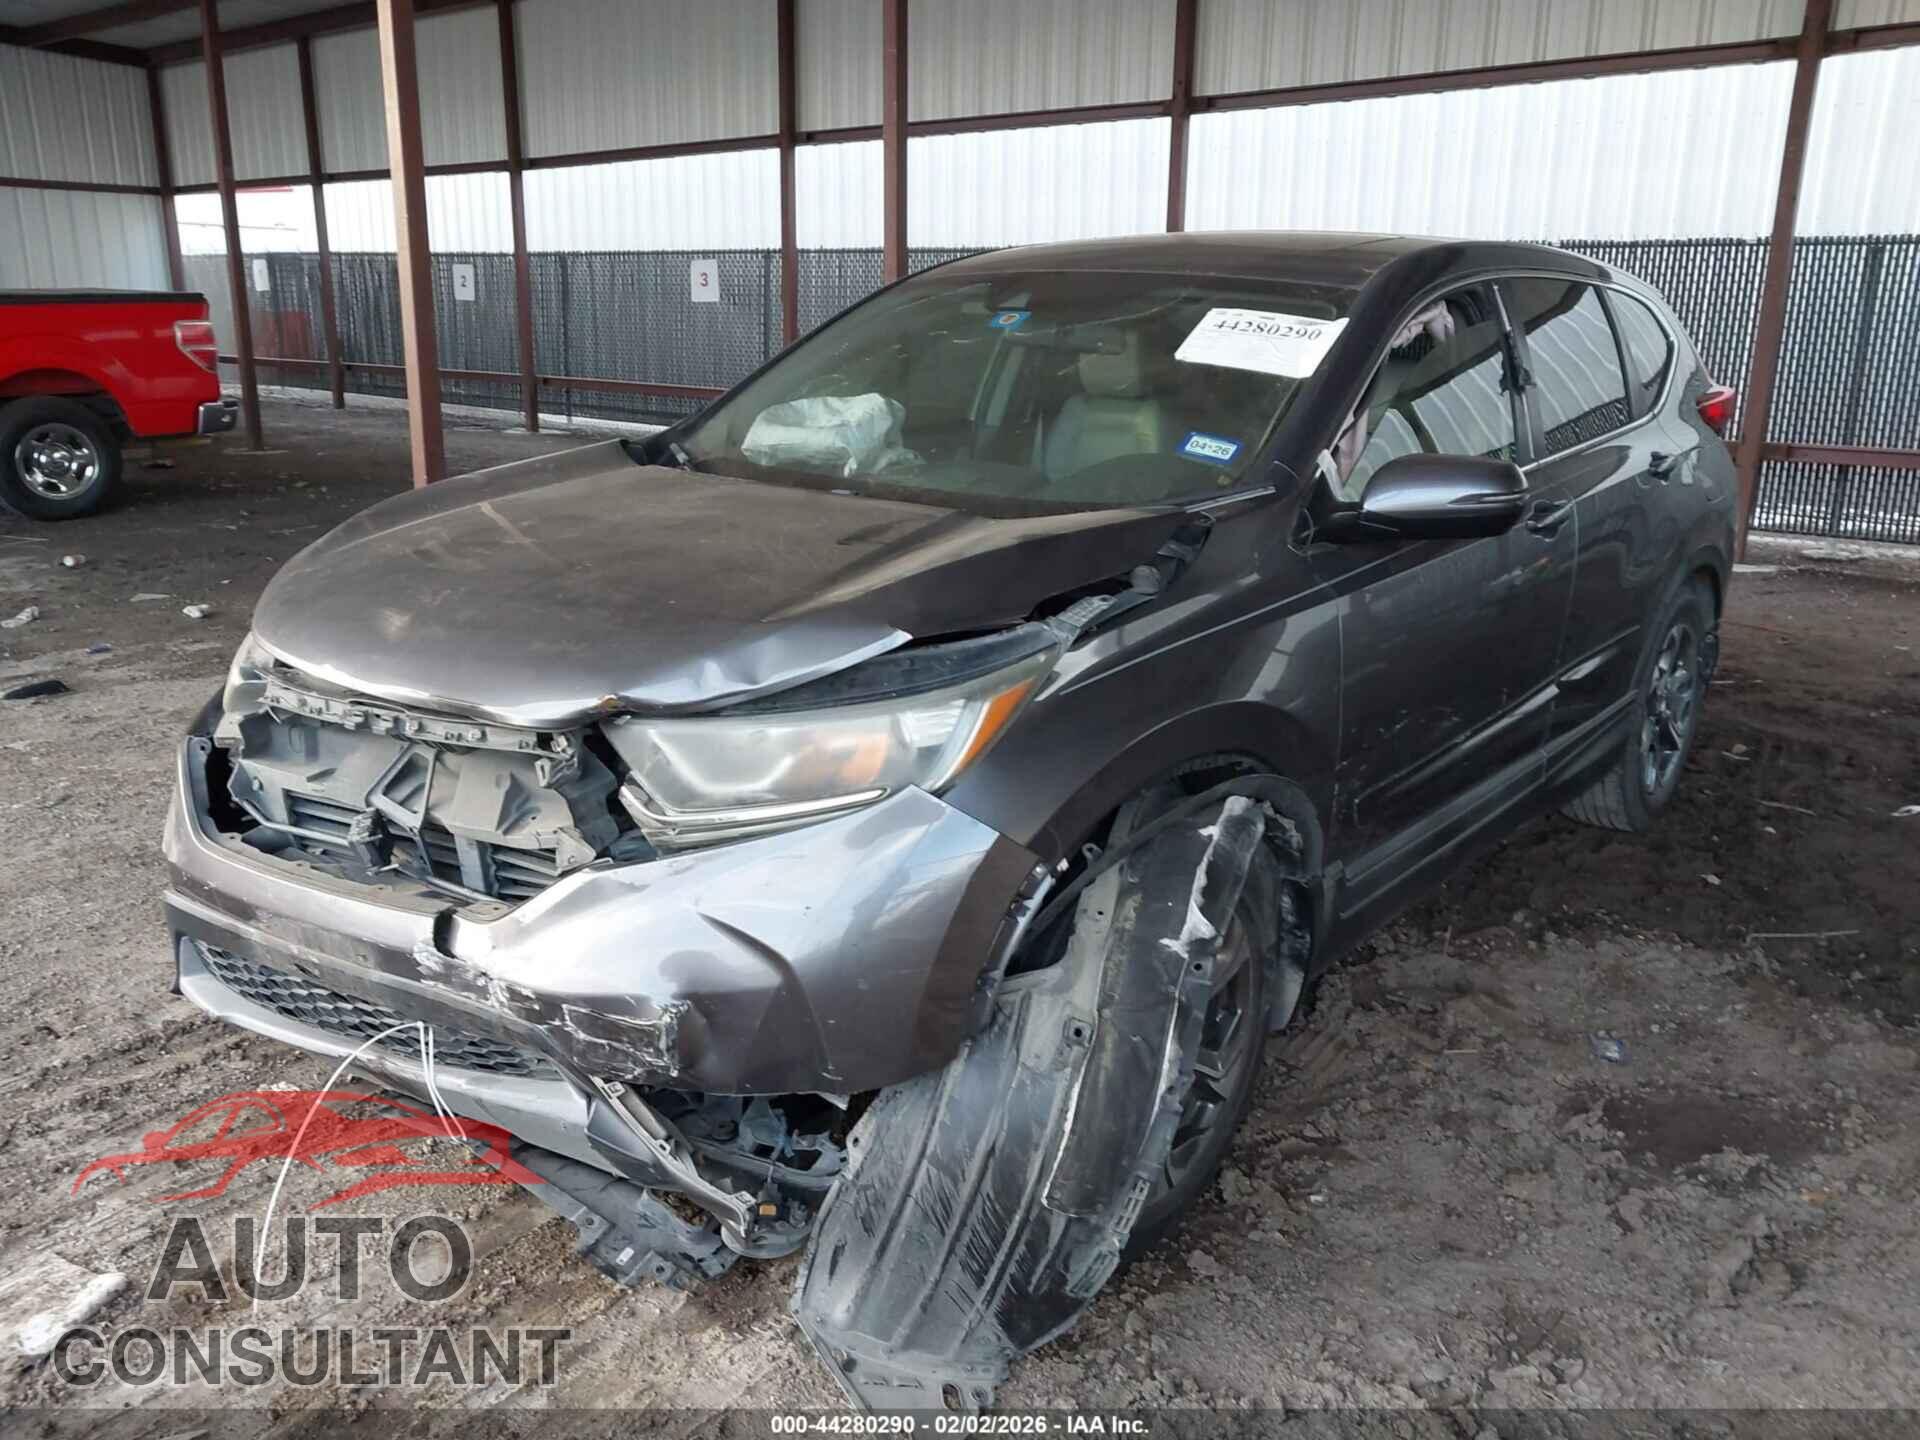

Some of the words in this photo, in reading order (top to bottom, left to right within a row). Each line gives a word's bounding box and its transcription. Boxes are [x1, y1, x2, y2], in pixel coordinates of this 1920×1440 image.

[460, 274, 467, 288] 2
[699, 271, 709, 288] 3
[1214, 319, 1323, 341] 44280290
